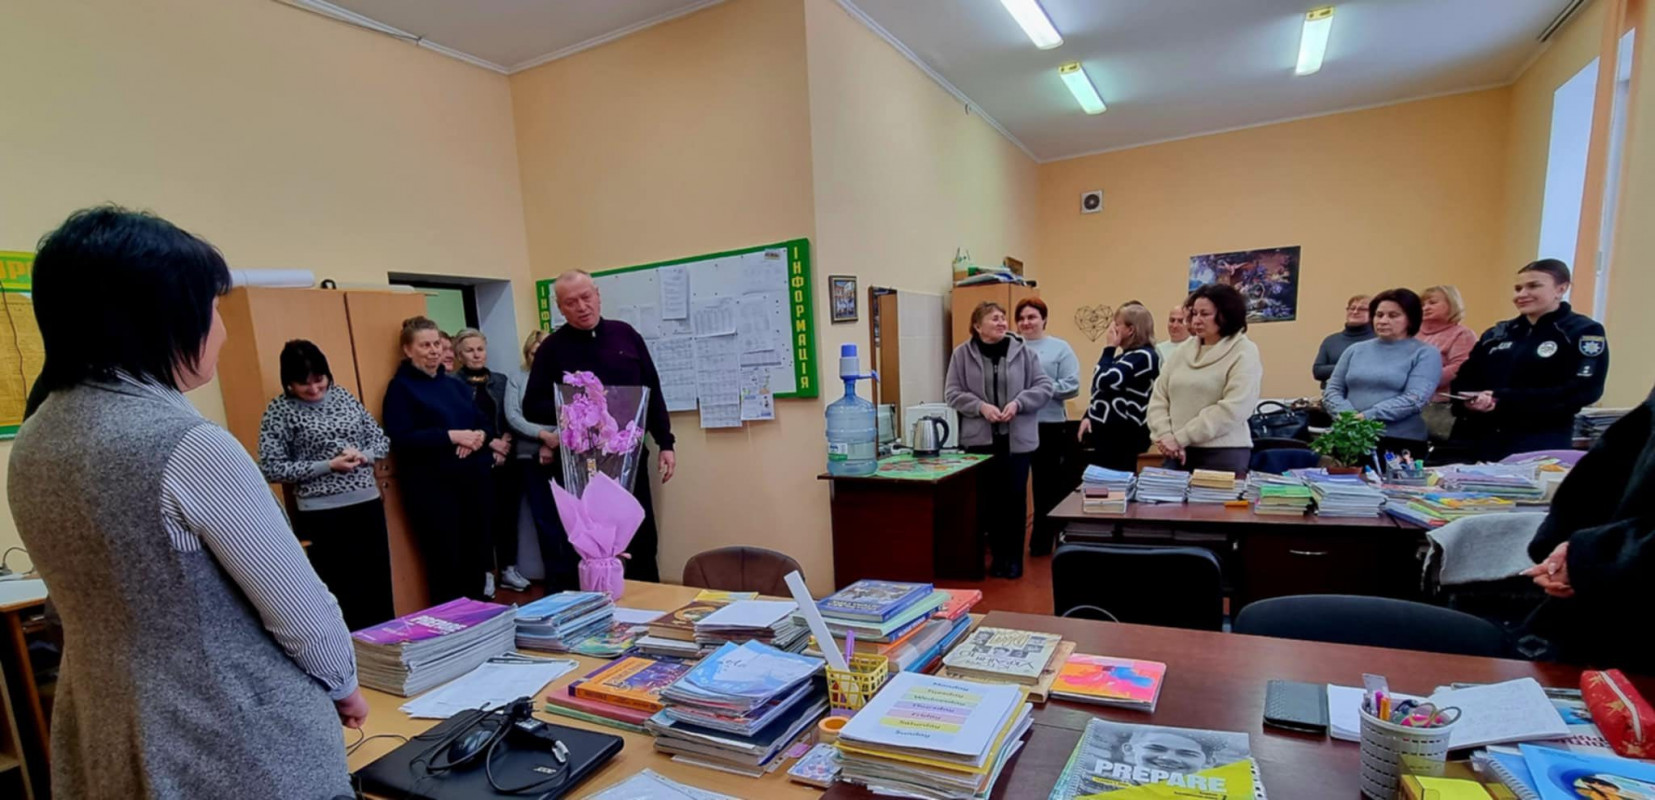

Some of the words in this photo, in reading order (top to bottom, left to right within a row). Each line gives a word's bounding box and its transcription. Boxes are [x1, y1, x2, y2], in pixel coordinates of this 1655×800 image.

[792, 246, 809, 388] ІНФОРМАЦІЯ
[933, 682, 969, 691] Monday
[928, 688, 965, 698] Tuesday
[914, 695, 966, 706] Wednesday
[912, 703, 955, 713] Thursday
[911, 712, 942, 720] Friday
[900, 720, 940, 729] Saturday
[896, 730, 930, 738] Sunday
[1095, 759, 1227, 793] PREPARE
